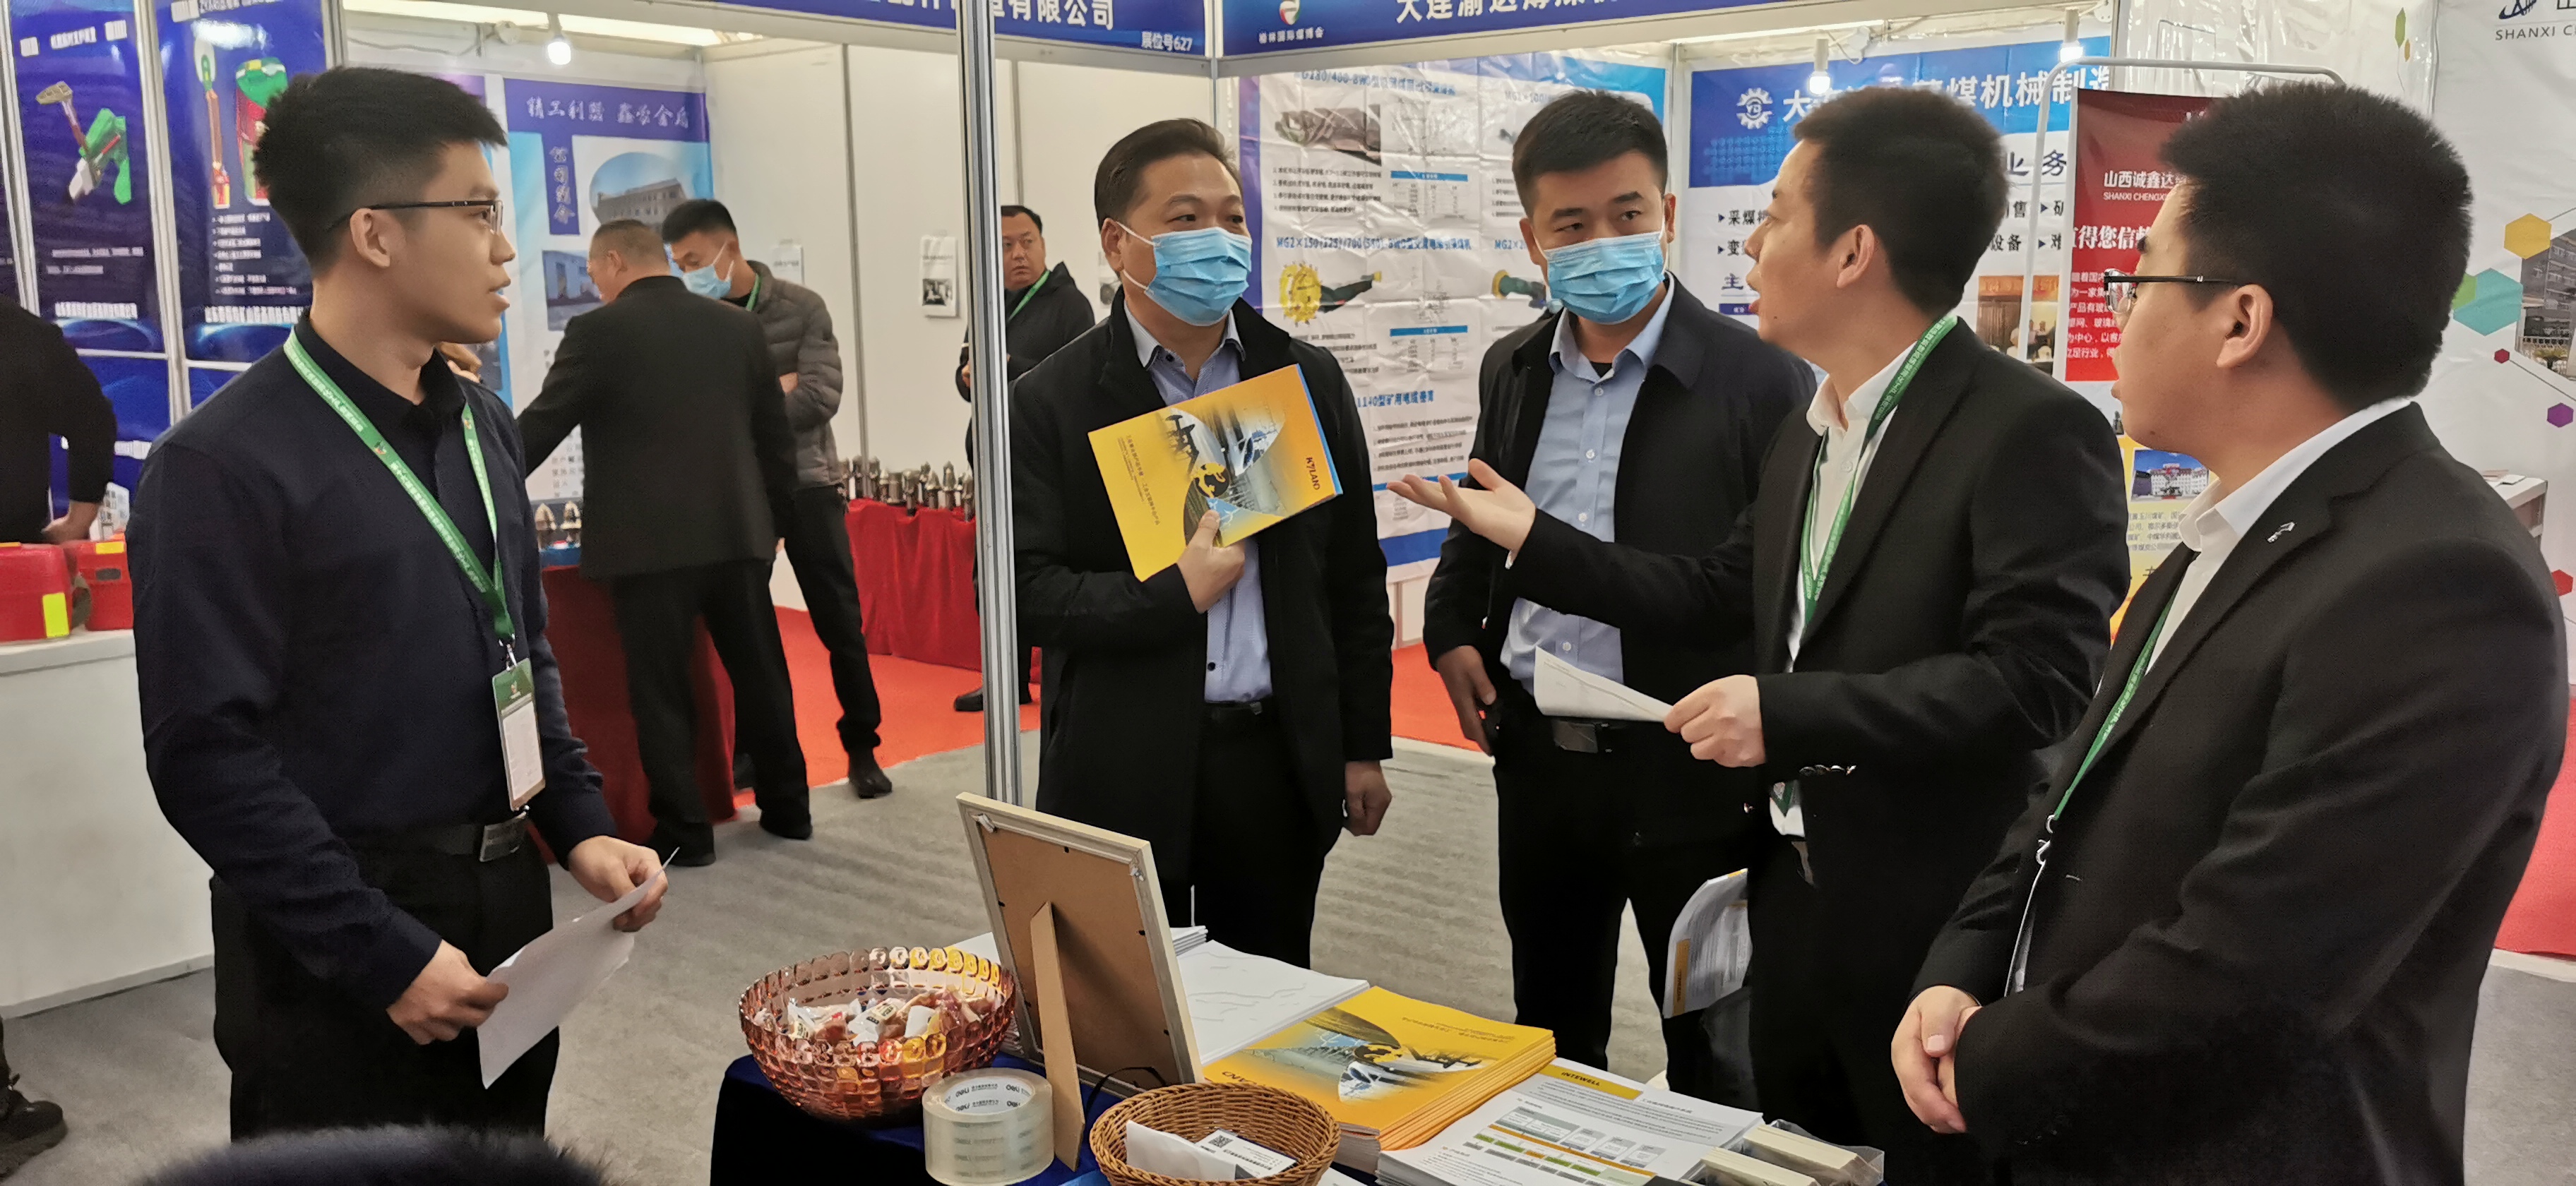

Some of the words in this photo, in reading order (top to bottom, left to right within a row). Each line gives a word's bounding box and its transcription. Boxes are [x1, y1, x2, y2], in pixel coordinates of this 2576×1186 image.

[1141, 31, 1193, 52] 展位号627
[2495, 26, 2556, 41] SHANXI
[2103, 191, 2133, 200] SHANXI
[1305, 456, 1321, 491] KYLAND
[1561, 1071, 1601, 1087] INTEWELL
